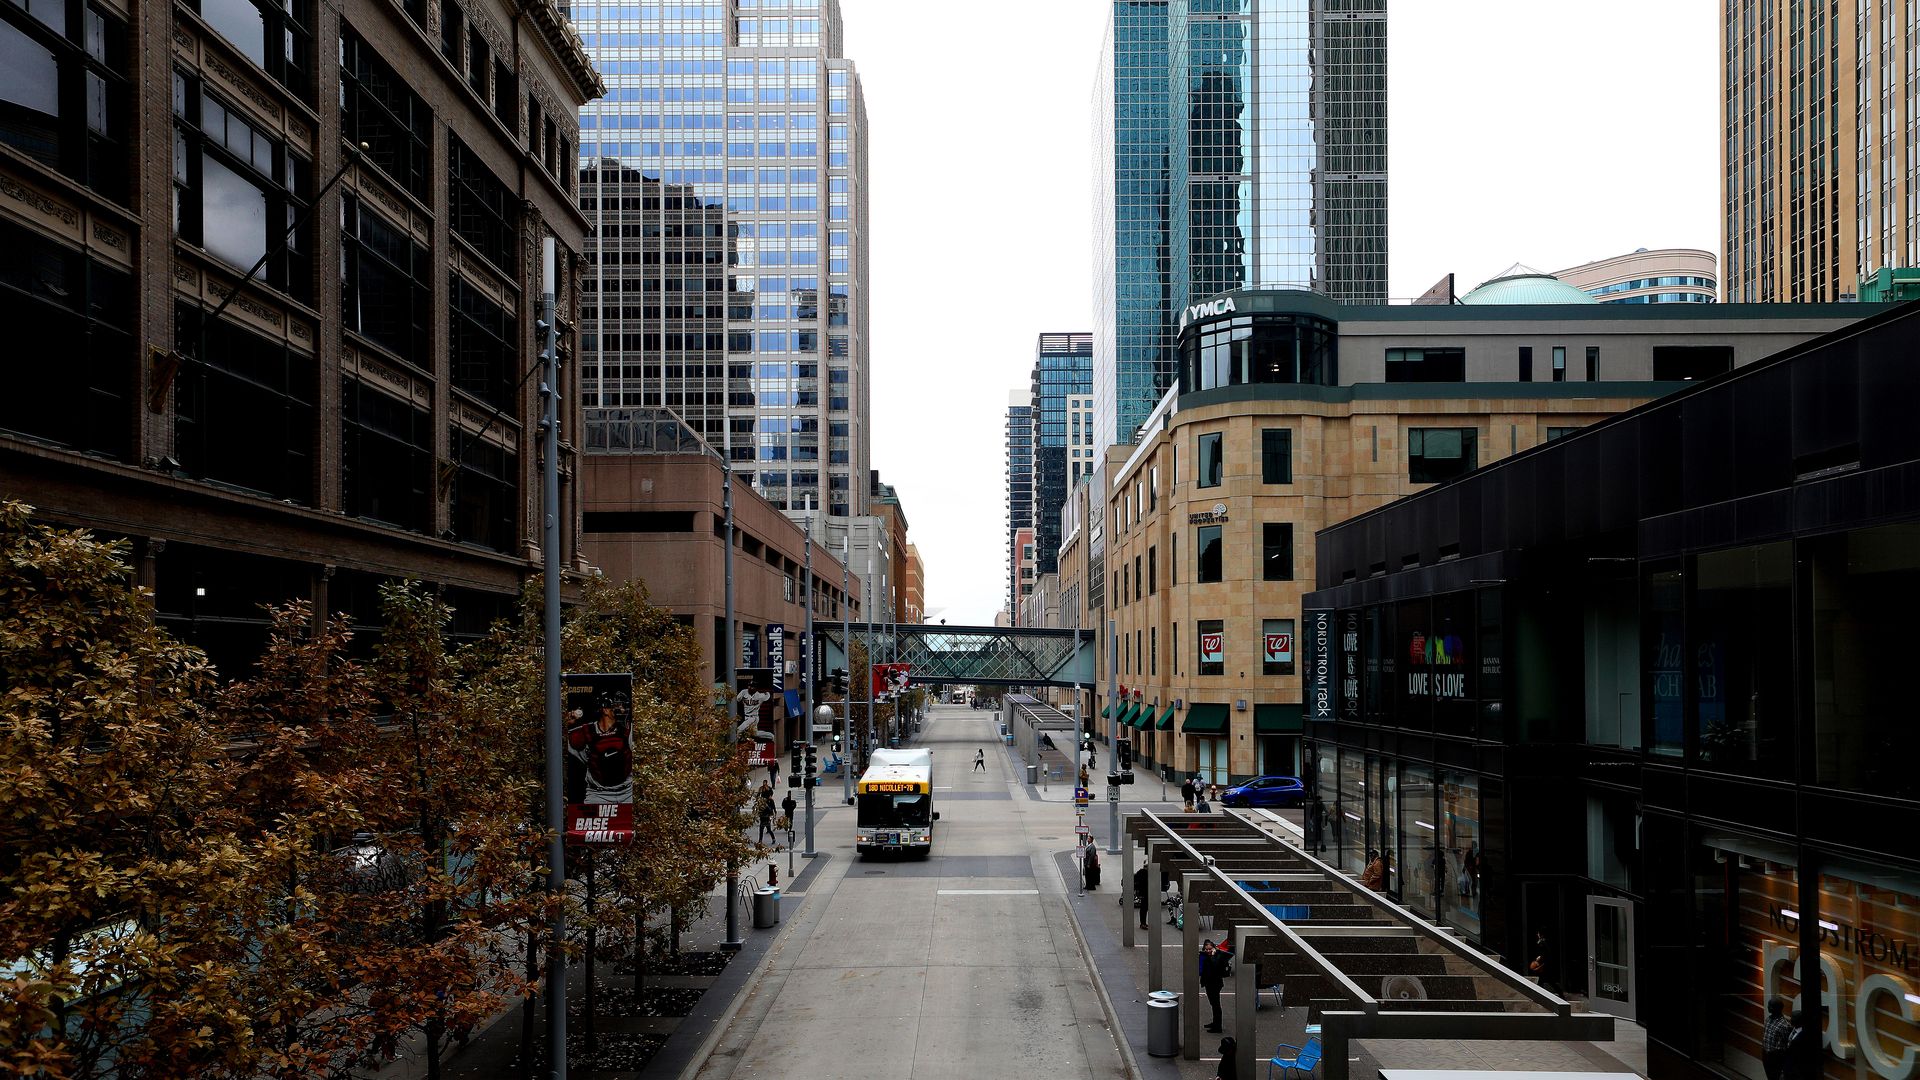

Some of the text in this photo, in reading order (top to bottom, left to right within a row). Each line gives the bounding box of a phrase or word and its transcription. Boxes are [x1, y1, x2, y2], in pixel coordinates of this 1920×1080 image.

[1190, 297, 1236, 320] YMCA
[768, 626, 783, 690] Marshalls
[1316, 613, 1332, 717] NORDSTROM rack
[1408, 672, 1428, 695] LOVE
[1442, 673, 1465, 698] LOVE
[755, 743, 767, 751] WE
[598, 804, 619, 818] WE
[575, 817, 609, 831] BASE
[585, 830, 615, 843] BALL
[1603, 983, 1624, 994] rack
